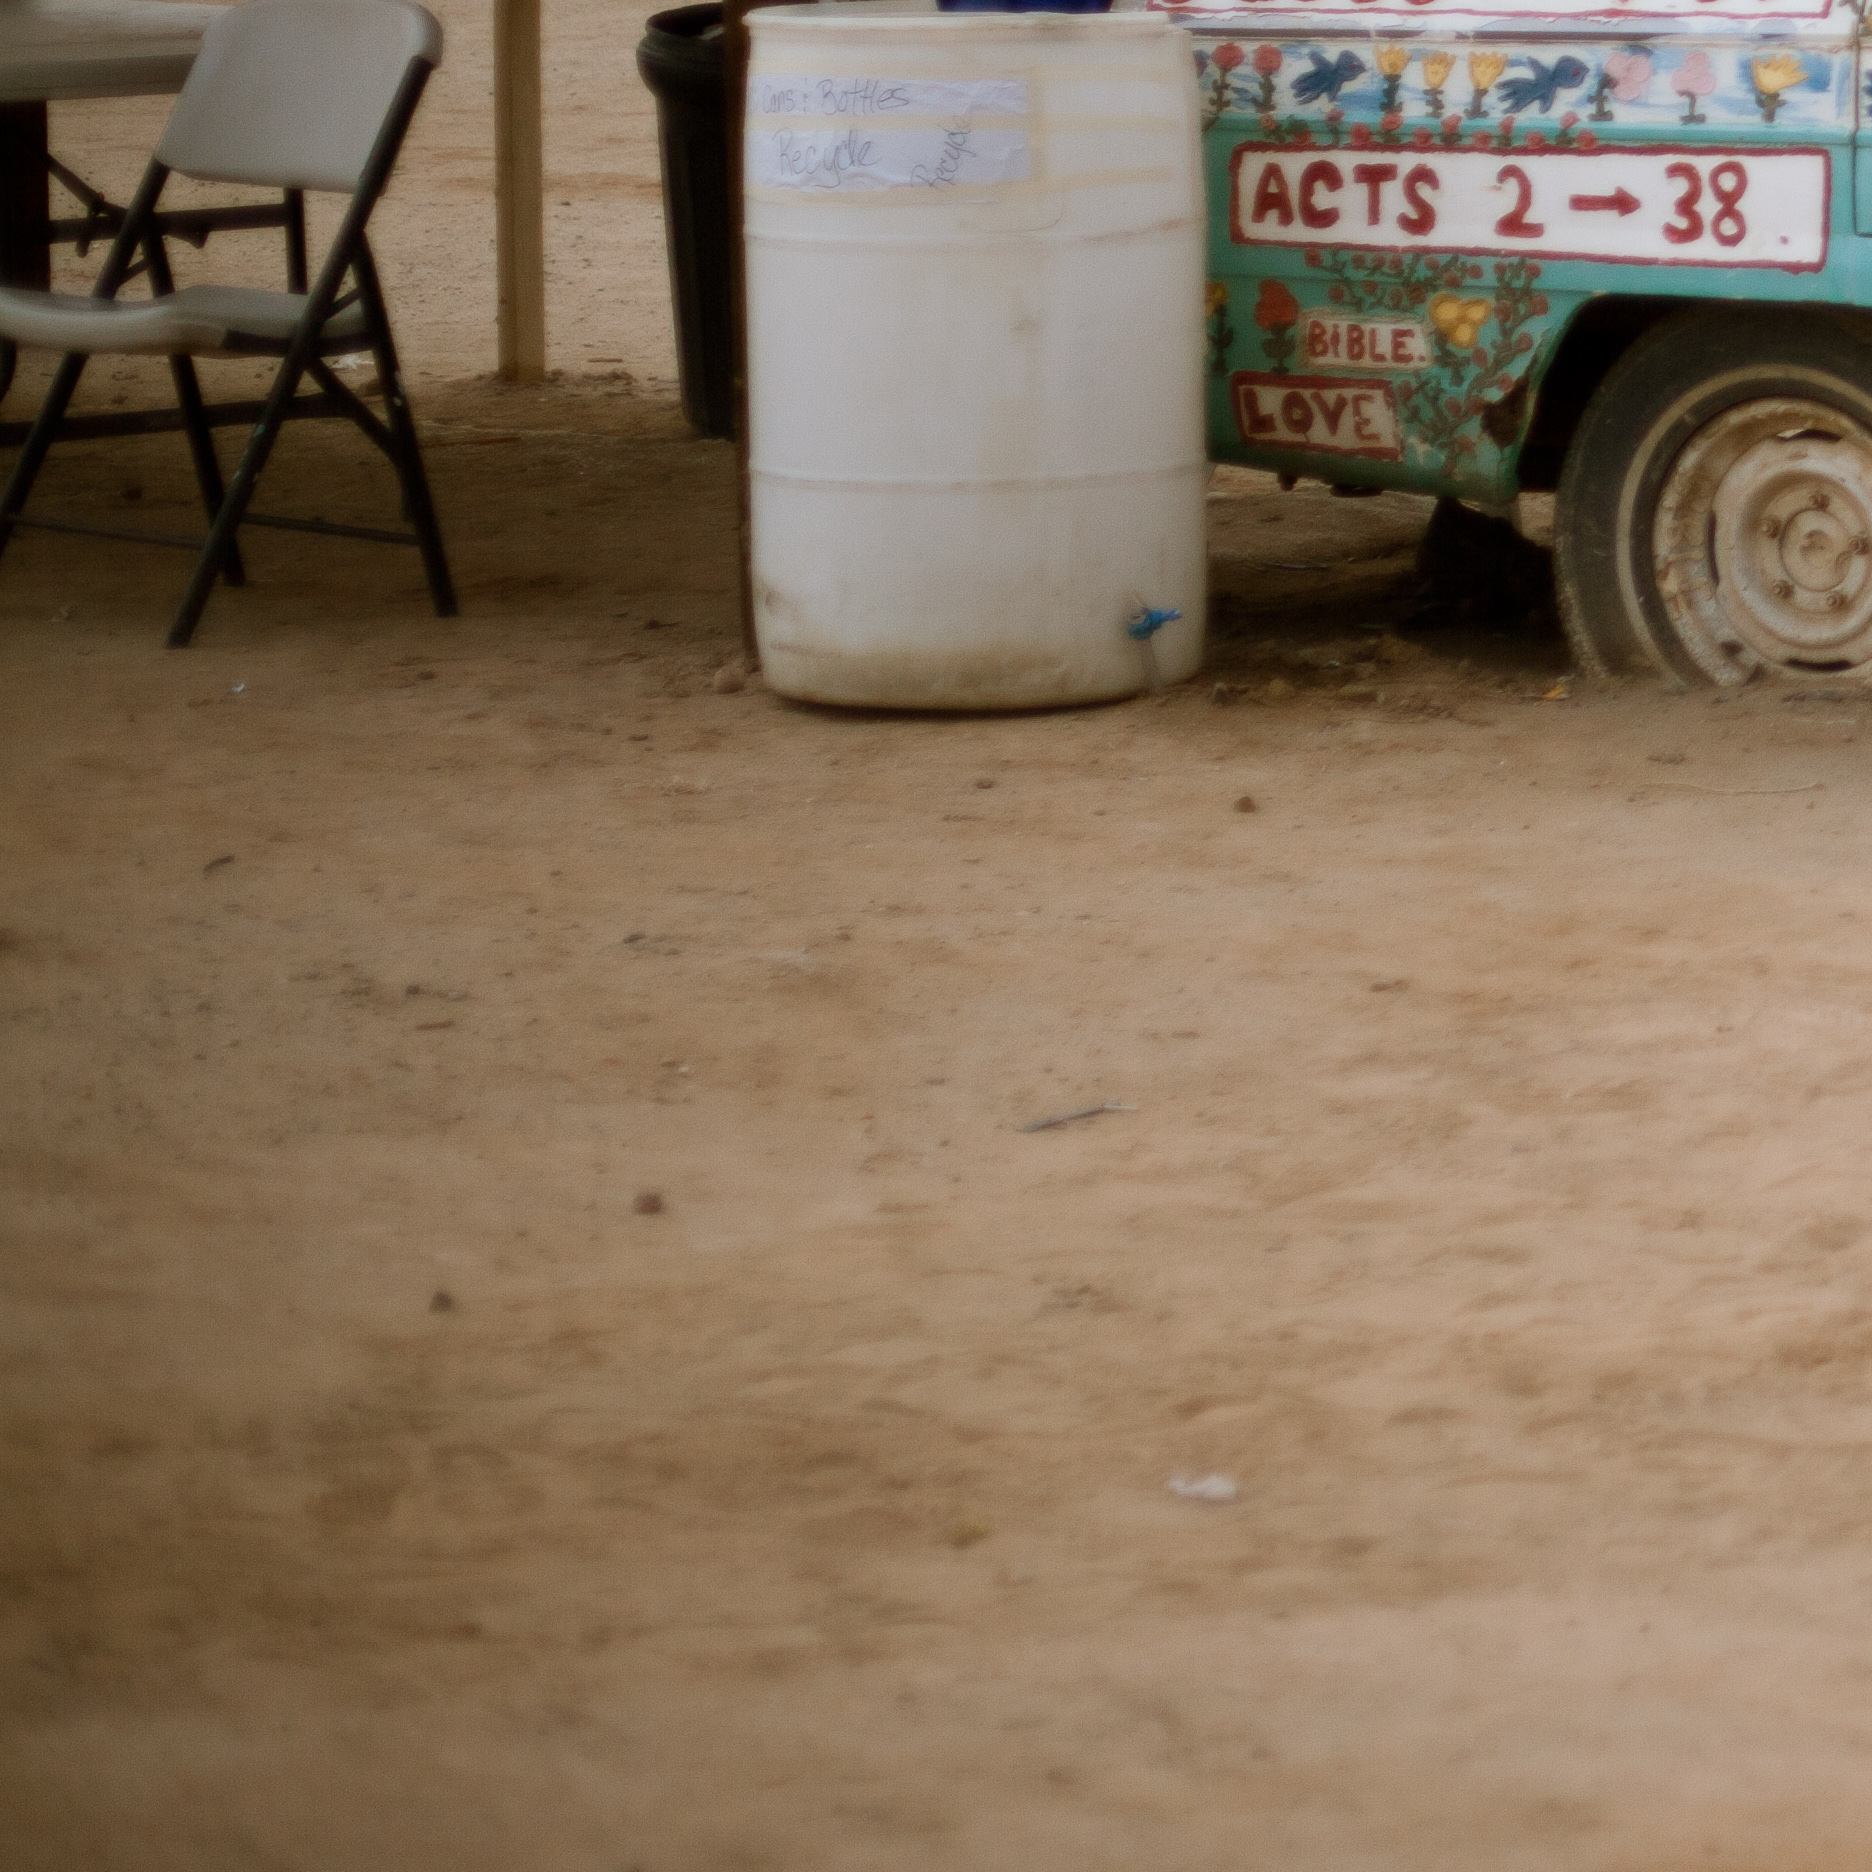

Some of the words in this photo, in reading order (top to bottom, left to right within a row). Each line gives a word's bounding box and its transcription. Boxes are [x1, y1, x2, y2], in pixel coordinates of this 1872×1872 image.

[816, 79, 911, 115] Bottles
[772, 127, 882, 188] Recycle
[1251, 160, 1440, 236] ACTS
[1495, 165, 1545, 239] 2
[1241, 389, 1392, 442] LOVE
